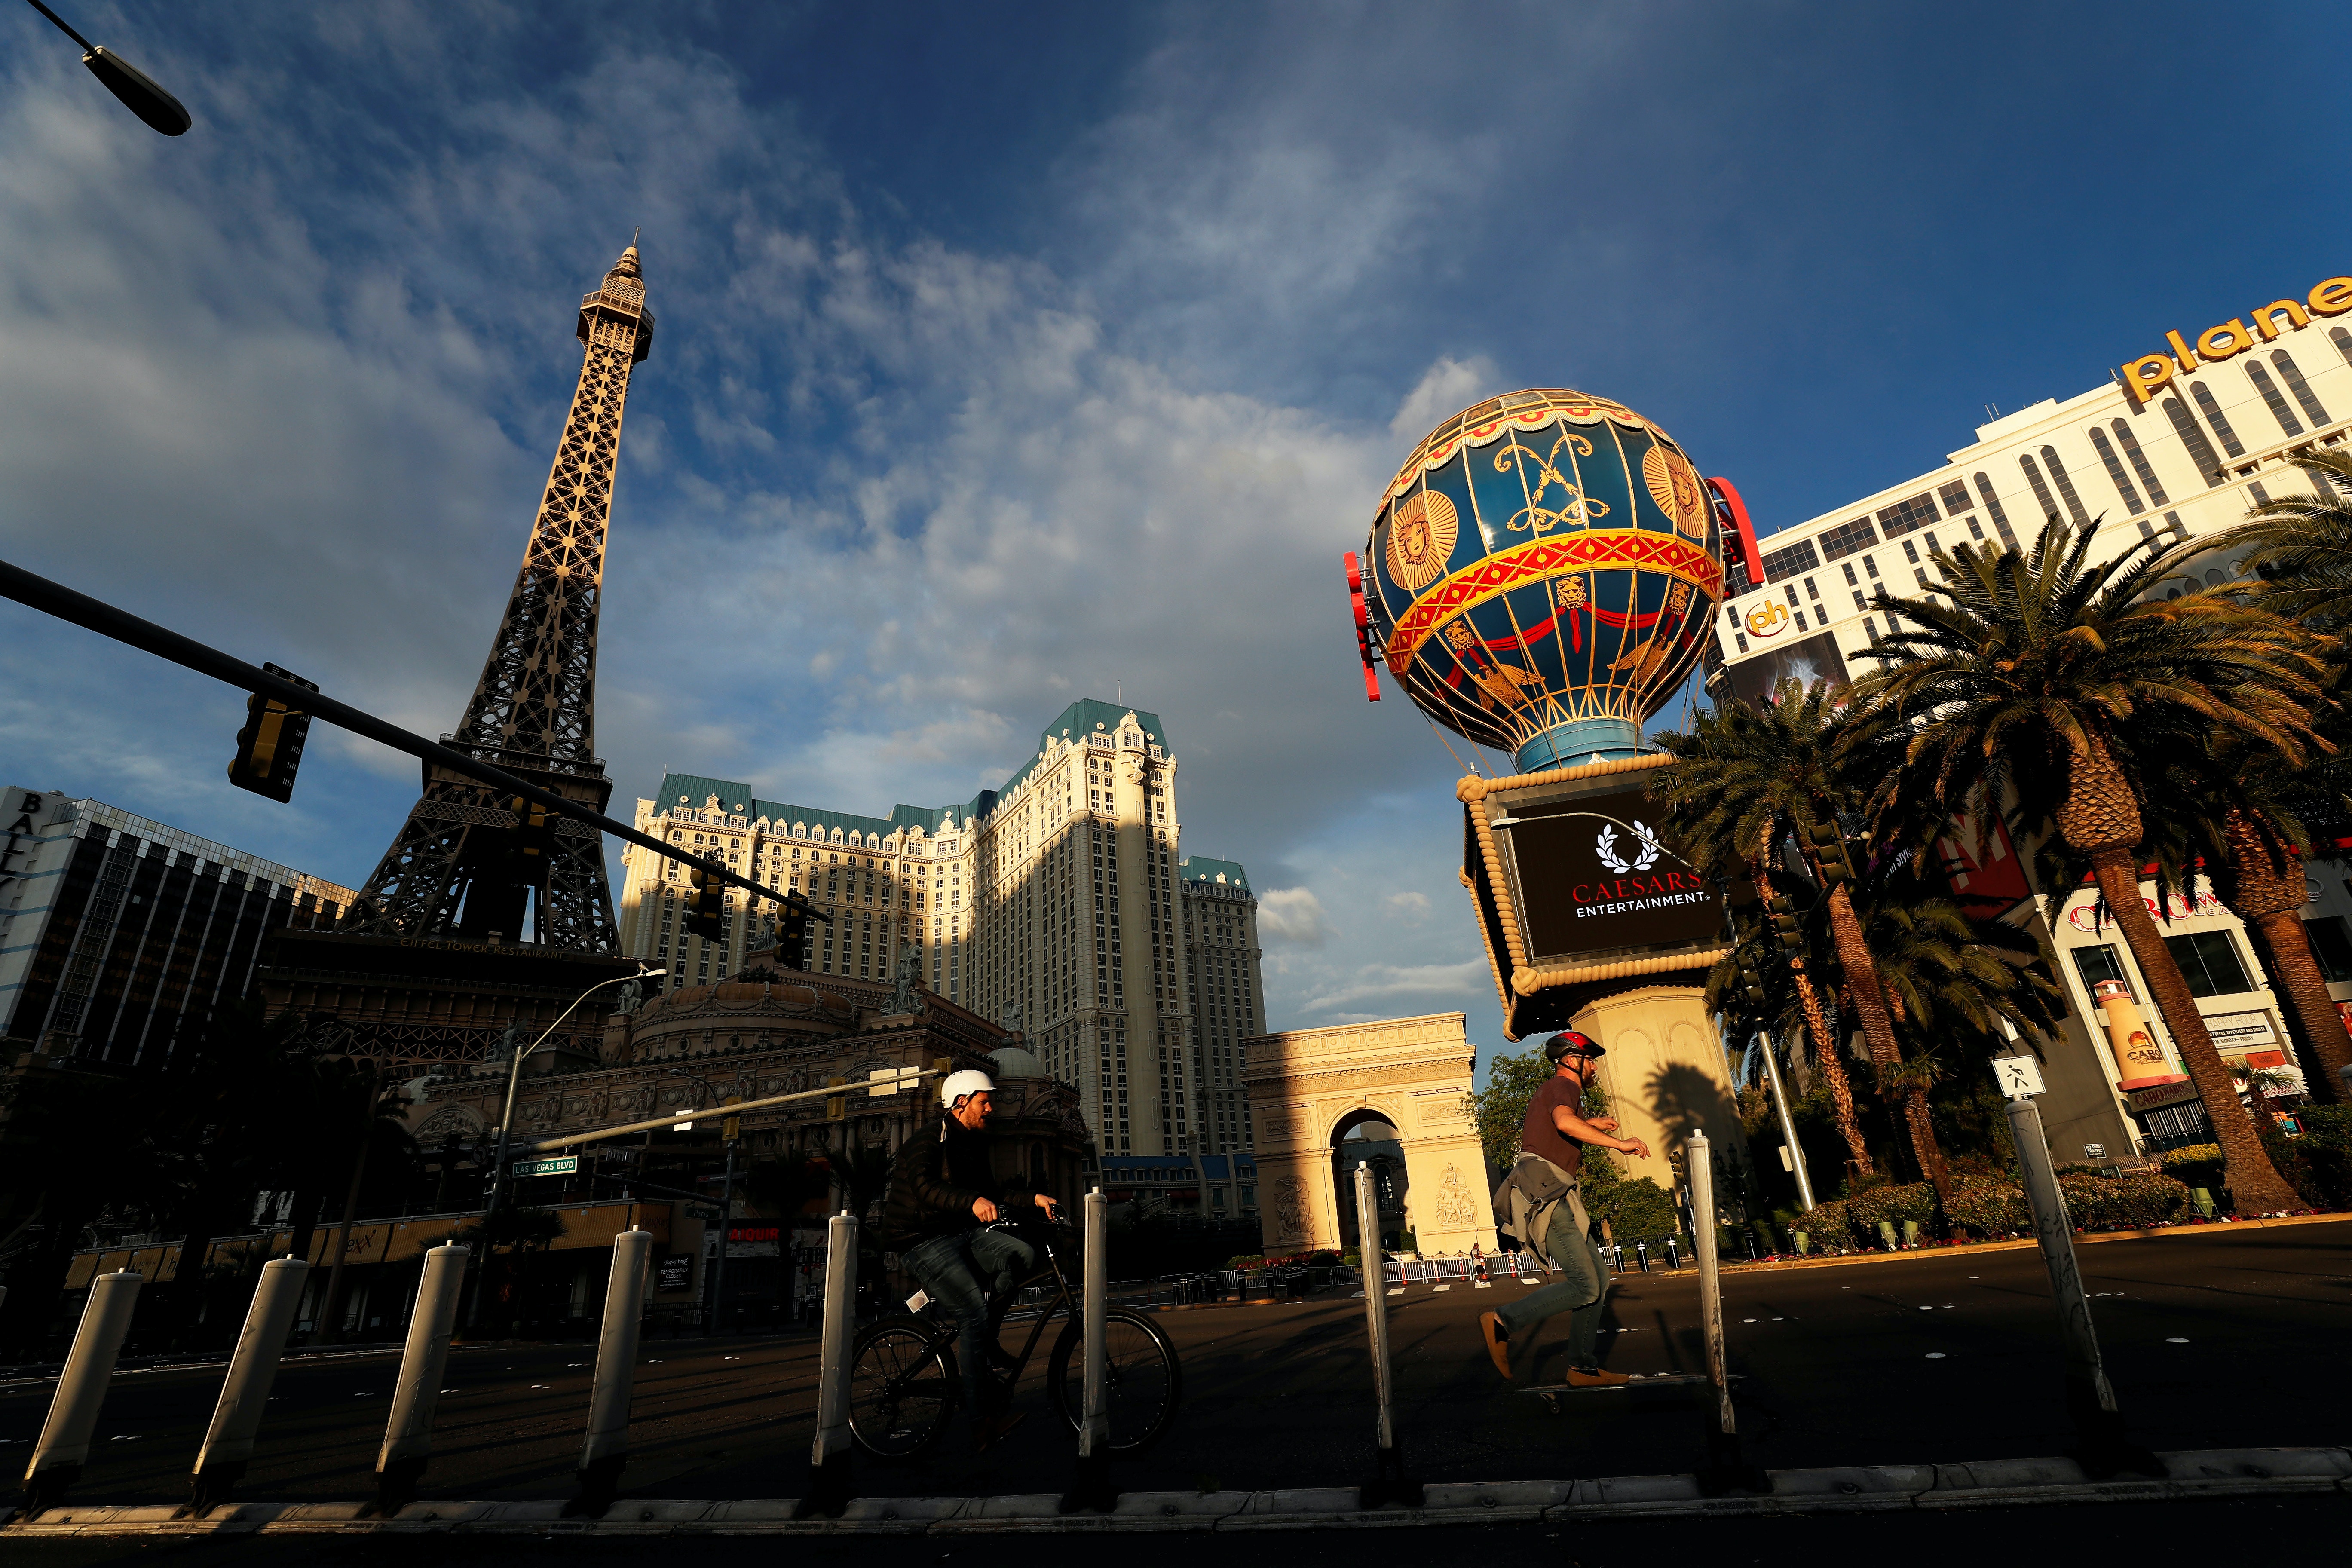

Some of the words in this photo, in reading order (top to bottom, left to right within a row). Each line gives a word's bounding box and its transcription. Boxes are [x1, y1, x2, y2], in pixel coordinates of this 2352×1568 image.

[1749, 600, 1788, 634] ph
[1573, 871, 1701, 903] CAESARS
[400, 938, 441, 949] EIFFEL
[445, 941, 487, 953] TOWER
[494, 946, 564, 959] RESTAURANT
[2205, 1017, 2233, 1029] HAPPY
[2235, 1014, 2258, 1026] HOUR
[2127, 1049, 2160, 1060] CABO
[2135, 1089, 2164, 1106] CABO
[533, 1163, 554, 1172] VEGAS
[557, 1161, 573, 1170] BLVD
[693, 1210, 709, 1218] Paris
